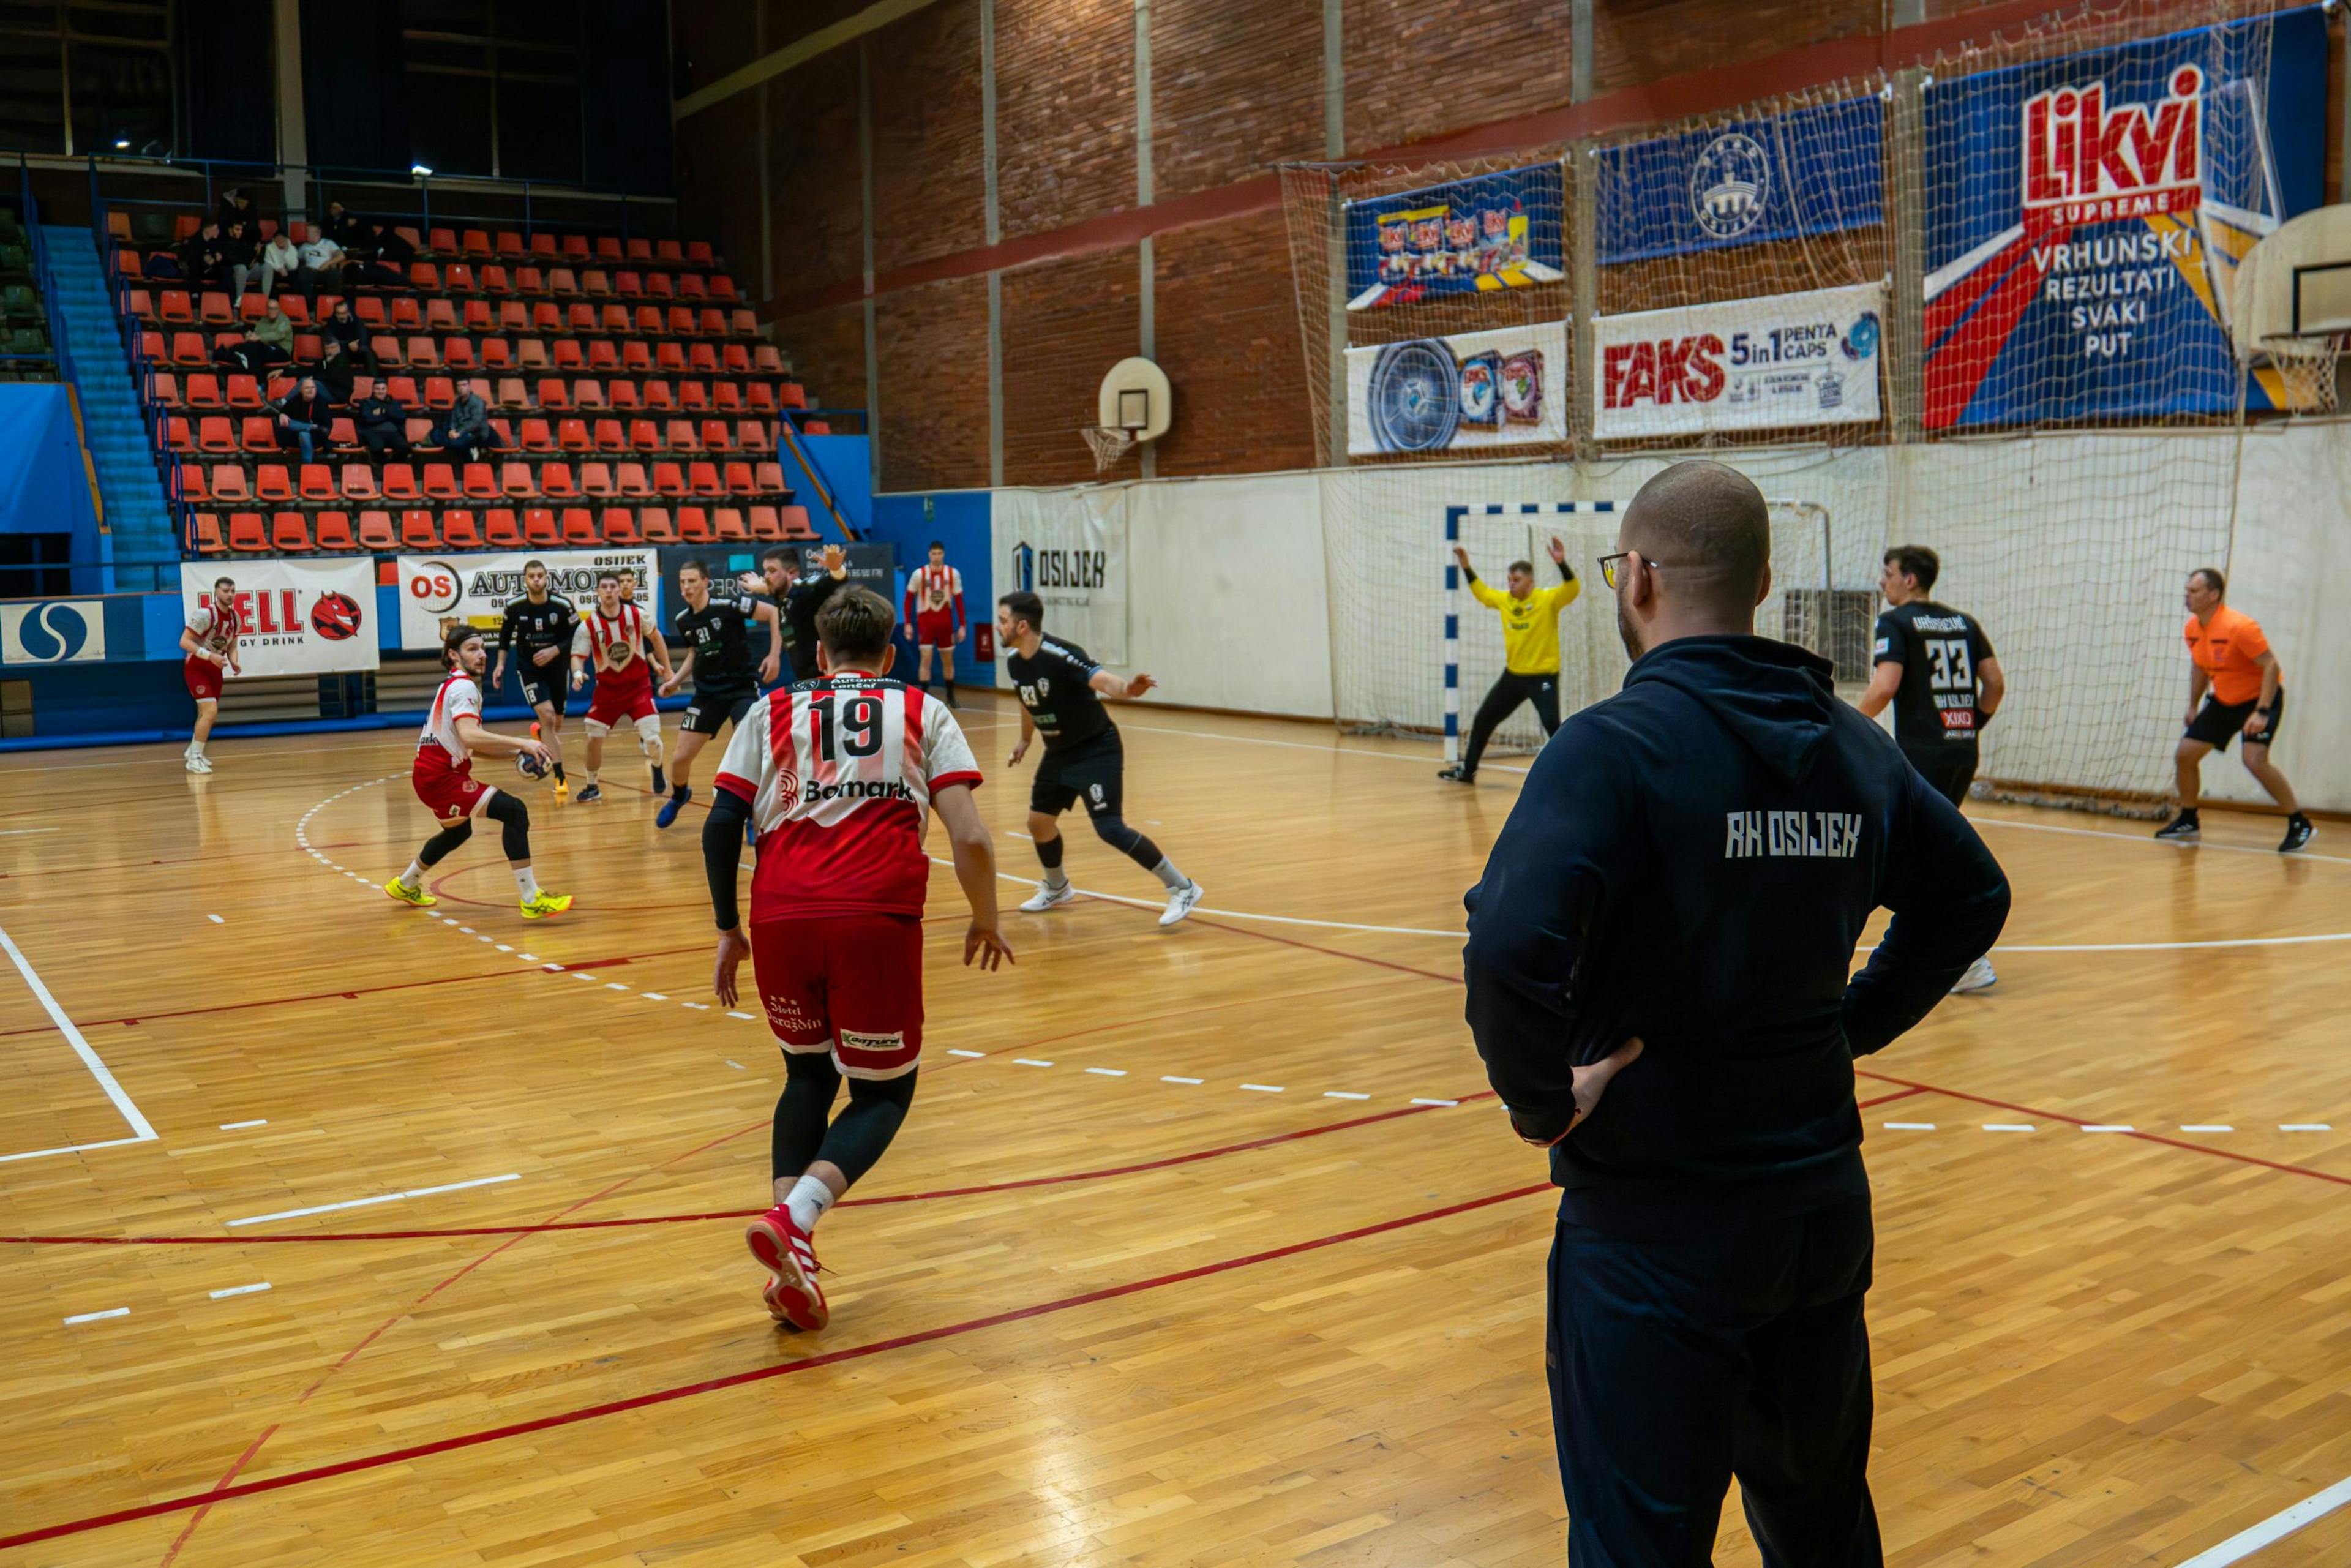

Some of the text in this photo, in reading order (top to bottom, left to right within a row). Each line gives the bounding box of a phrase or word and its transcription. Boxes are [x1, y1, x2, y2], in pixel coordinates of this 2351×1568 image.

[2053, 192, 2169, 225] SUPREME
[2032, 228, 2192, 274] VRHUNSKI
[2045, 266, 2176, 302] REZULTATI
[2072, 301, 2146, 329] SVAKI
[1783, 323, 1837, 342] PENTA
[2085, 332, 2132, 358] PUT
[1784, 342, 1828, 359] CAPS
[1603, 333, 1725, 409] FAKS
[594, 555, 647, 566] OSIJEK
[1039, 550, 1105, 588] OSIJEK
[411, 575, 452, 598] OS
[263, 636, 304, 647] DRINK
[696, 627, 711, 645] 31
[1925, 639, 1973, 689] 33
[808, 696, 883, 761] 19
[804, 776, 915, 803] Bomark
[1725, 811, 1862, 858] RK OSIJEK
